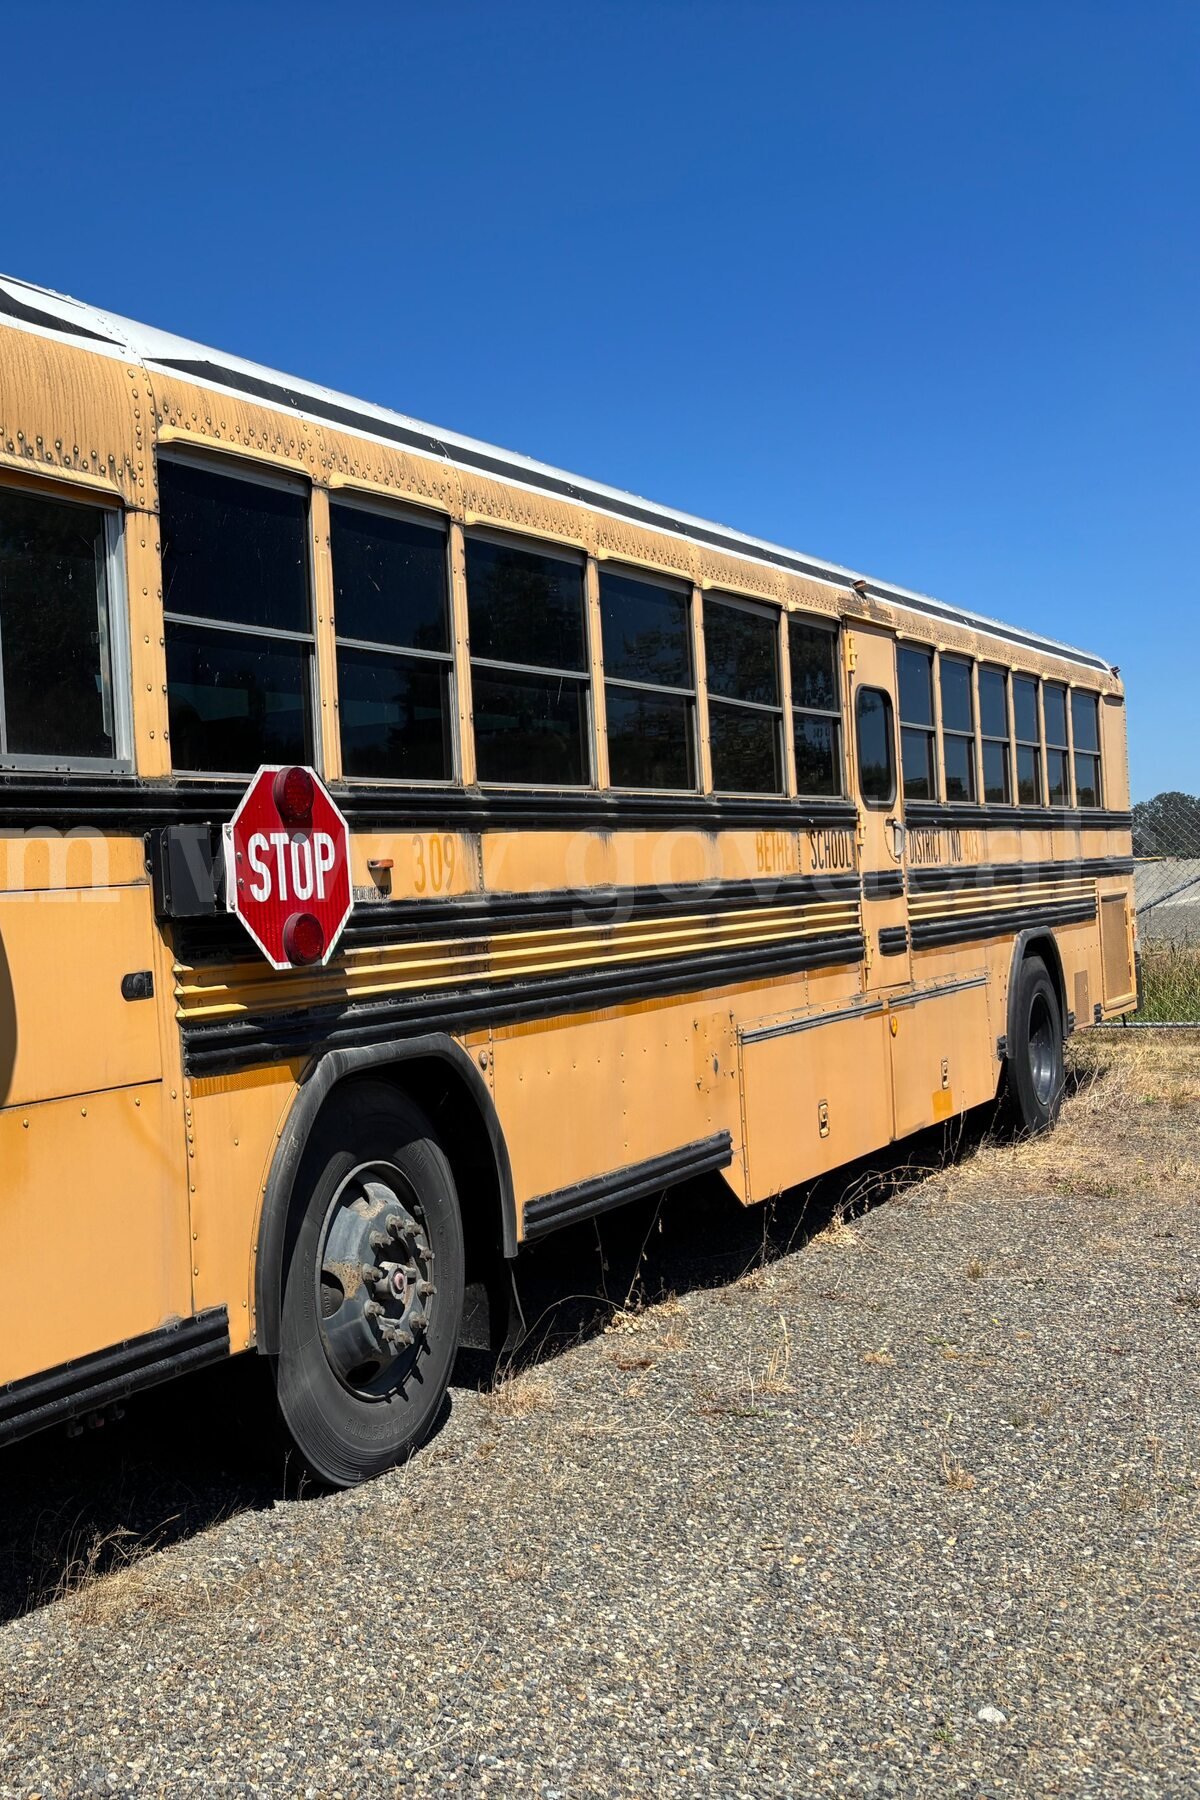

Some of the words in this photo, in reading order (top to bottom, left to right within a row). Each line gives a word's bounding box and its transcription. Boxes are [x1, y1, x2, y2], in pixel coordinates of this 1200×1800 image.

[247, 832, 336, 902] STOP
[412, 834, 456, 894] 309
[809, 830, 852, 870] SCHOOL
[909, 829, 942, 864] DISTRICT
